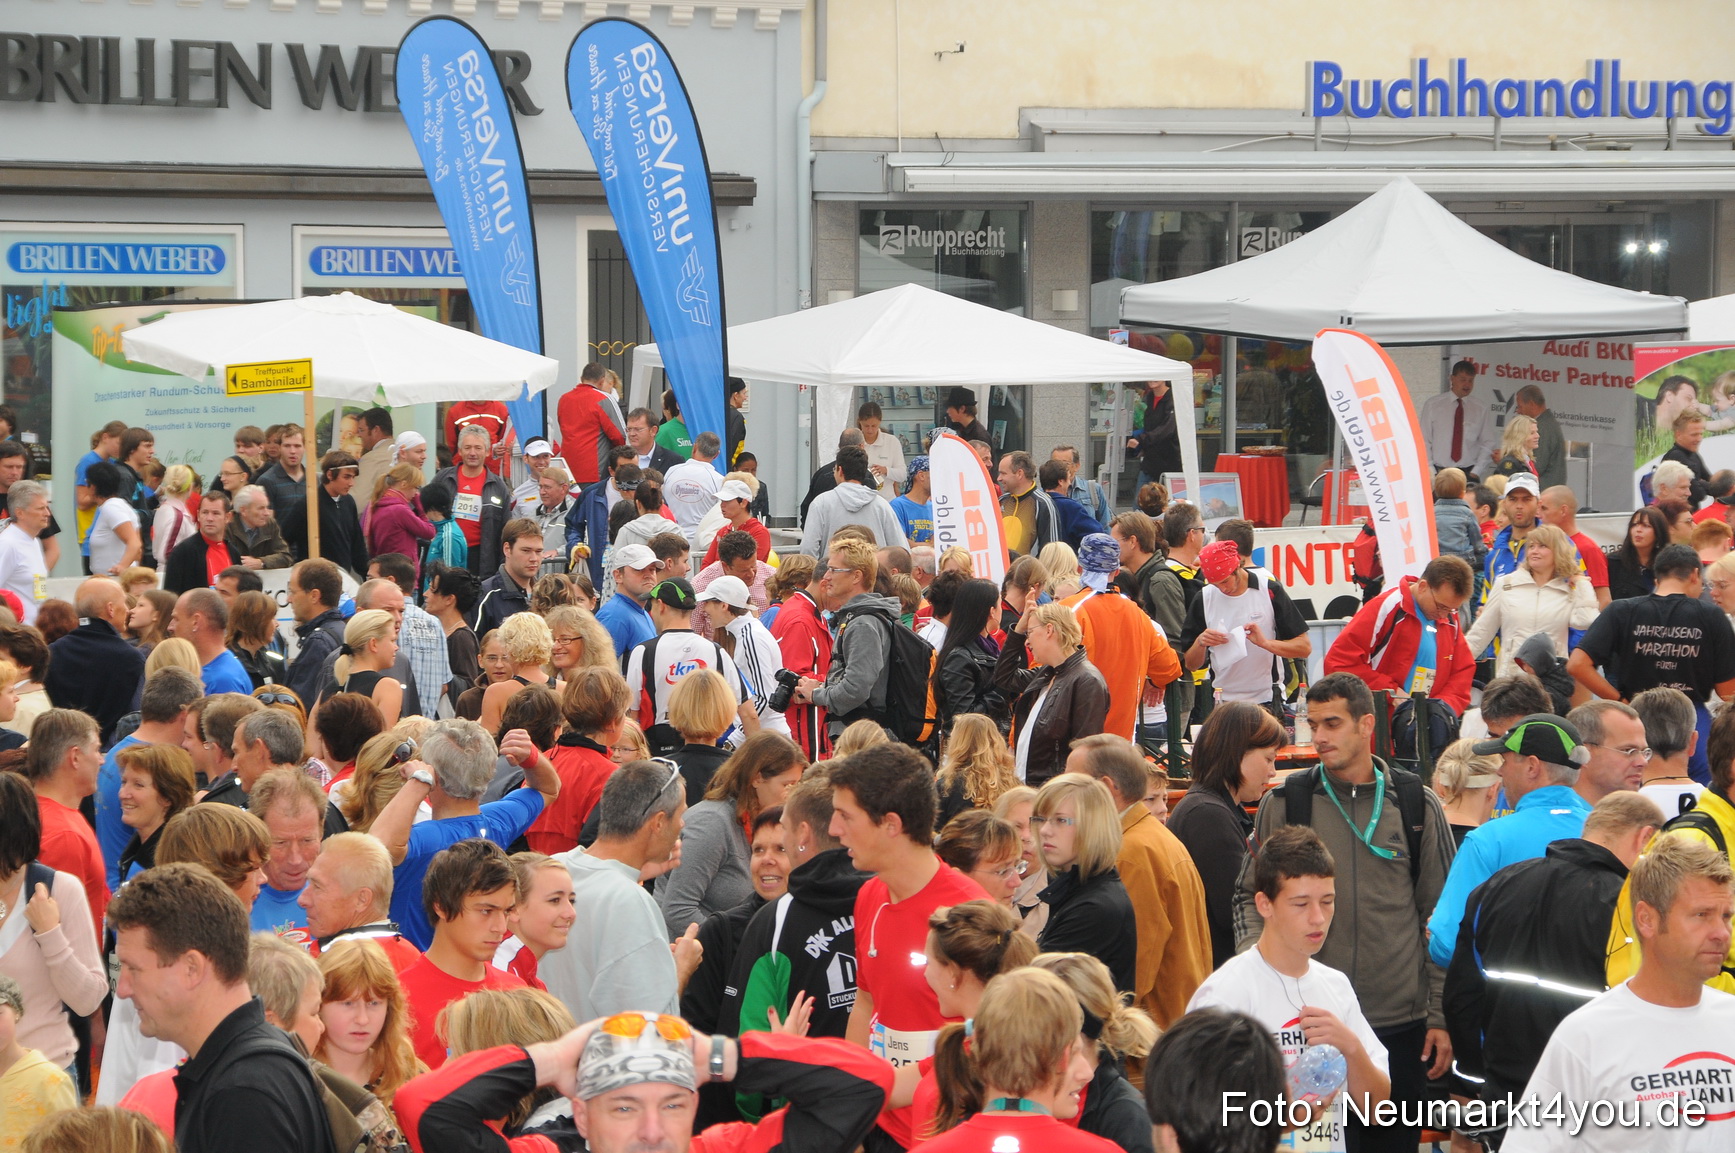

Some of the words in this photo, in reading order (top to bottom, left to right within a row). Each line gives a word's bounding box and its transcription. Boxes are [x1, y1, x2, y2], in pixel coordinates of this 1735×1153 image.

[0, 31, 272, 110] BRILLEN
[1306, 57, 1735, 135] Buchhandlung
[907, 225, 1006, 255] Rupprecht
[19, 244, 119, 271] BRILLEN
[125, 246, 217, 272] WEBER
[320, 248, 415, 274] BRILLEN
[951, 247, 1005, 258] Buchhandlung
[1542, 340, 1590, 358] Audi
[254, 366, 294, 377] Treffpunkt
[1495, 363, 1561, 383] starker
[1567, 366, 1635, 389] Partne
[241, 374, 306, 390] Bambinilauf
[145, 407, 200, 417] Zukunftsschutz
[203, 406, 209, 414] &
[210, 405, 255, 415] Sicherheit
[1553, 410, 1617, 424] bskrankenkasse
[145, 422, 184, 431] Gesundheit
[187, 421, 193, 430] &
[194, 420, 231, 430] Vorsorge
[457, 502, 479, 513] 2015
[1633, 624, 1703, 640] JAHRTAUSEND
[1635, 641, 1701, 659] MARATHON
[887, 1035, 909, 1051] Jens
[1630, 1069, 1732, 1092] GERHART
[1301, 1121, 1340, 1142] 3445
